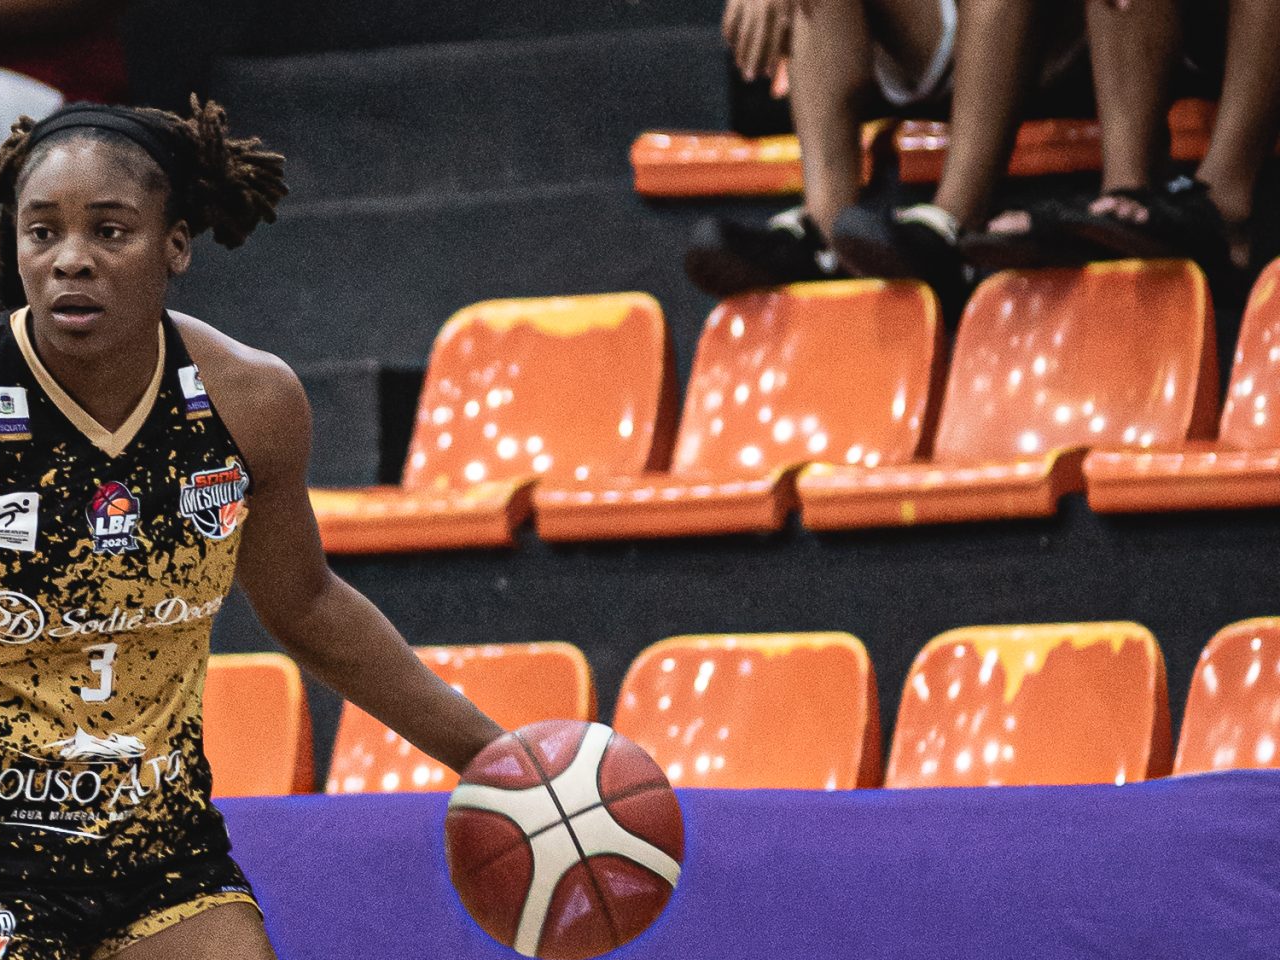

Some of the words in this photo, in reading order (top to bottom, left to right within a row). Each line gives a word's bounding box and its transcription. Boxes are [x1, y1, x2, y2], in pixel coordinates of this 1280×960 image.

[95, 514, 138, 536] LBF
[101, 536, 128, 548] 2026
[80, 642, 118, 704] 3
